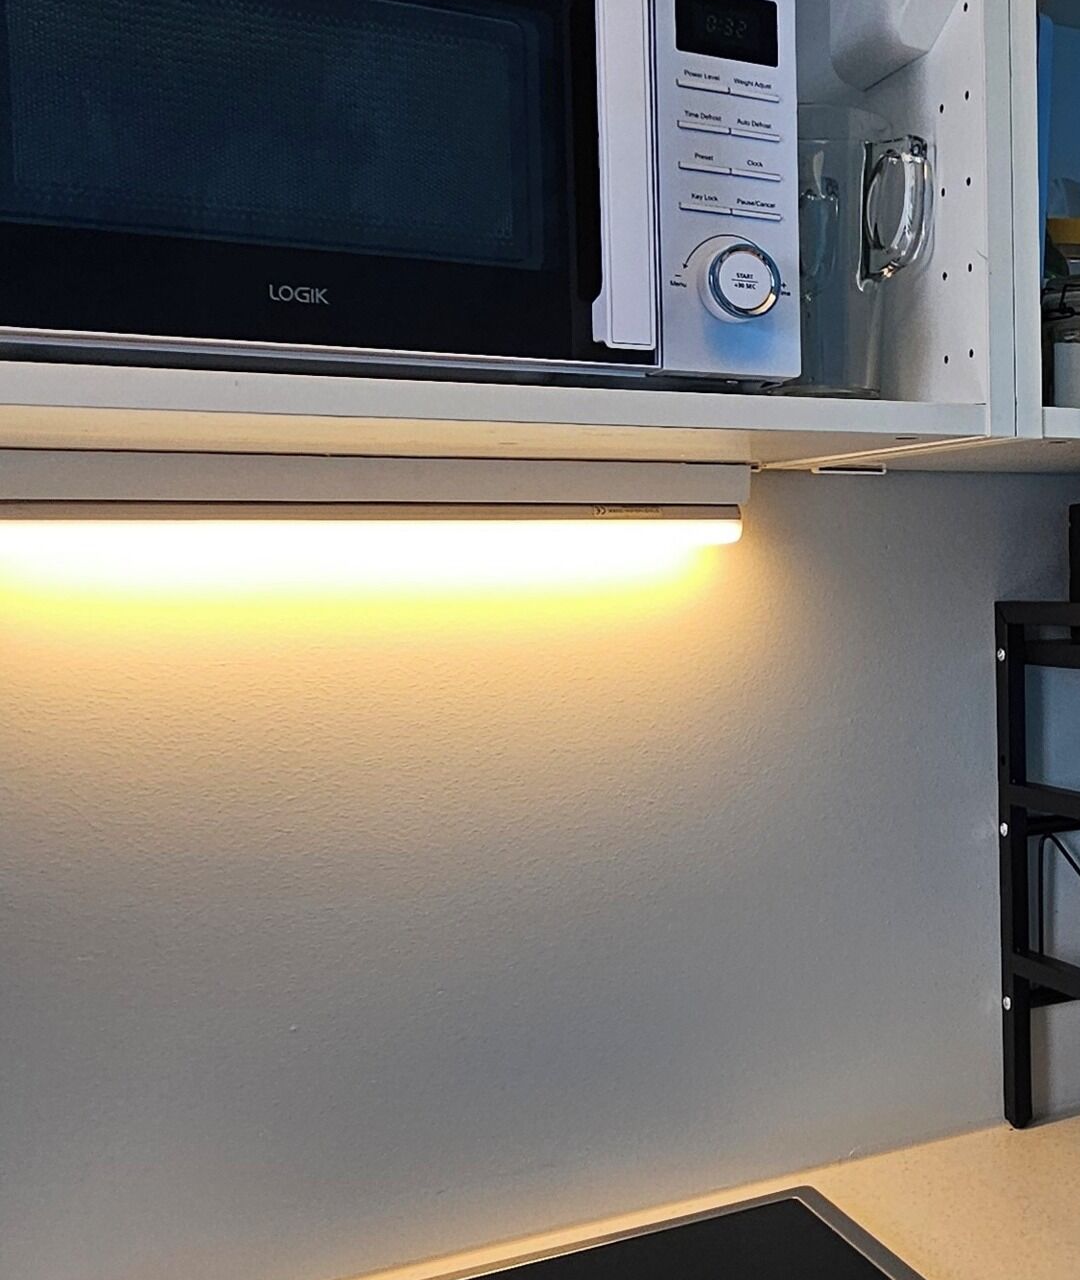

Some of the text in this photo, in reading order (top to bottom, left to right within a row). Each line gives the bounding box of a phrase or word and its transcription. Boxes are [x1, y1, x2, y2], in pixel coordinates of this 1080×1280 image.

[684, 69, 702, 78] Power
[733, 78, 753, 86] Weight
[685, 110, 721, 121] Time Defrost
[737, 118, 771, 129] Auto Defrost
[694, 152, 713, 160] Preset
[691, 193, 703, 201] Key
[736, 272, 753, 280] START
[269, 284, 330, 305] LOGIK
